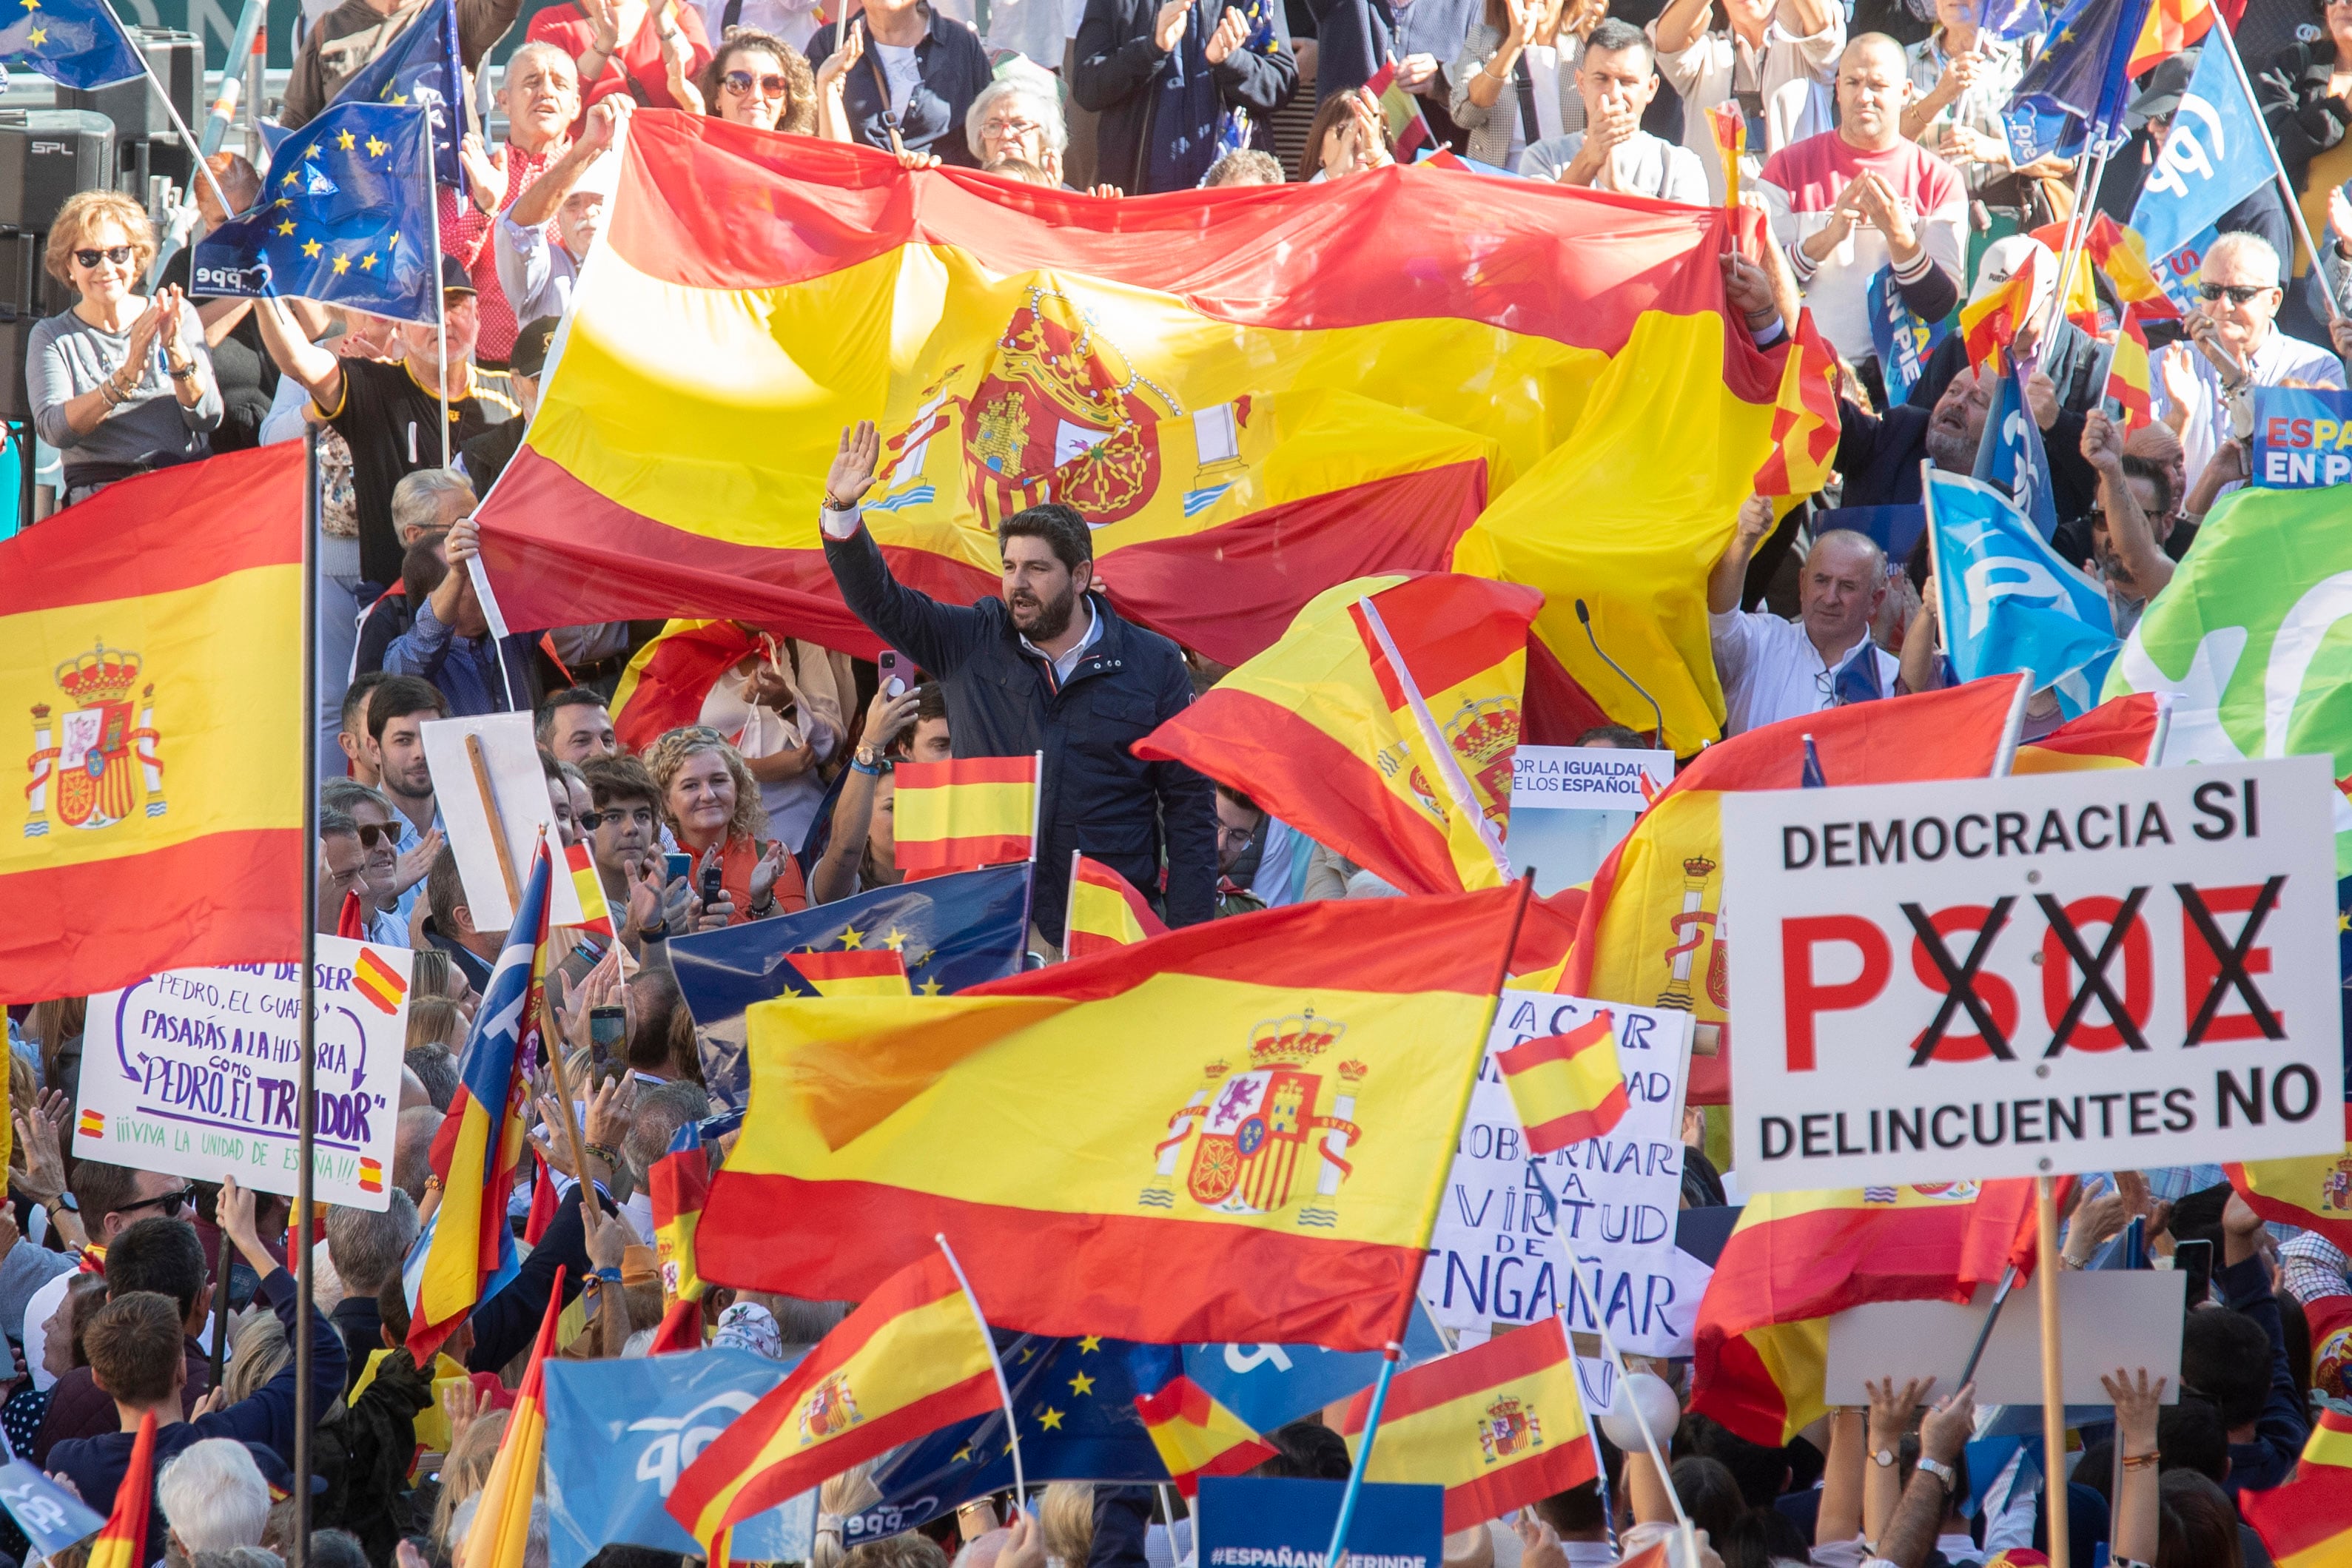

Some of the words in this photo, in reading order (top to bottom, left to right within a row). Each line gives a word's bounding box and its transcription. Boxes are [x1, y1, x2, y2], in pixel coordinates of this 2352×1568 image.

[31, 141, 73, 155] SPL
[1893, 324, 1922, 387] PIE
[2265, 451, 2316, 484] EN
[1528, 778, 1559, 791] LOS
[1562, 777, 1641, 794] ESPAÑOL
[1539, 761, 1559, 774] LA
[1782, 801, 2174, 871] DEMOCRACIA
[2191, 778, 2260, 842] SI
[314, 963, 352, 992] SER
[1781, 882, 2285, 1073] PSOE
[229, 990, 252, 1014] EL
[1493, 997, 1657, 1049] ACR
[141, 1009, 227, 1051] PASARÁS
[272, 1036, 346, 1074] HISRIA
[1761, 1088, 2197, 1161] DELINCUENTES
[2218, 1063, 2322, 1128] NO
[174, 1128, 190, 1153] LA
[202, 1133, 244, 1161] UNIDAD
[252, 1141, 269, 1166] DE
[1456, 1123, 1679, 1177] OBRNAR
[1496, 1234, 1546, 1257] DE
[1428, 1250, 1681, 1338] NGAÑAR
